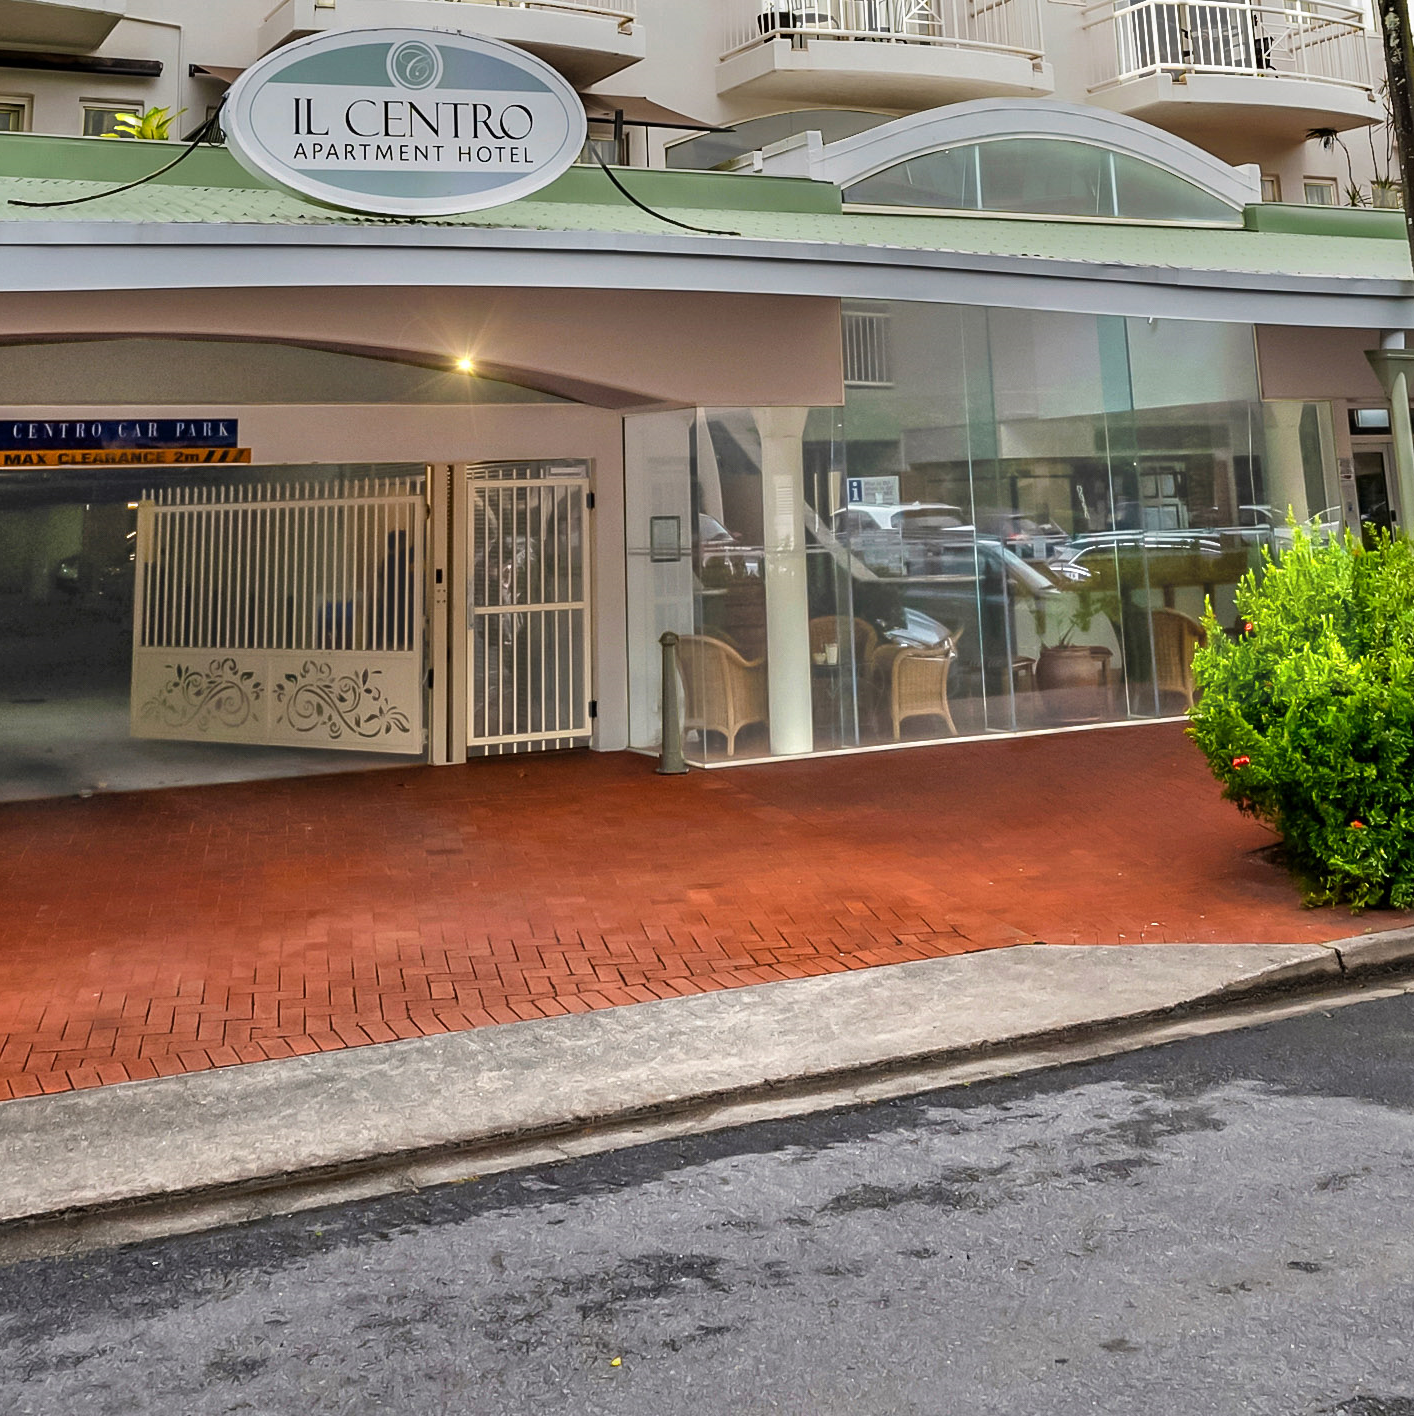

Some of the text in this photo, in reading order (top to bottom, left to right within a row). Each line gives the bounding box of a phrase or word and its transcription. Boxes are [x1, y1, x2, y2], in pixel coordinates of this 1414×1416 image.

[293, 97, 533, 140] IL CENTRO
[293, 143, 534, 163] APARTMENT HOTEL
[13, 422, 102, 439] CENTRO
[118, 422, 158, 437] CAR
[176, 422, 230, 437] PARK
[4, 451, 199, 465] MAX CLEARANCE 2m
